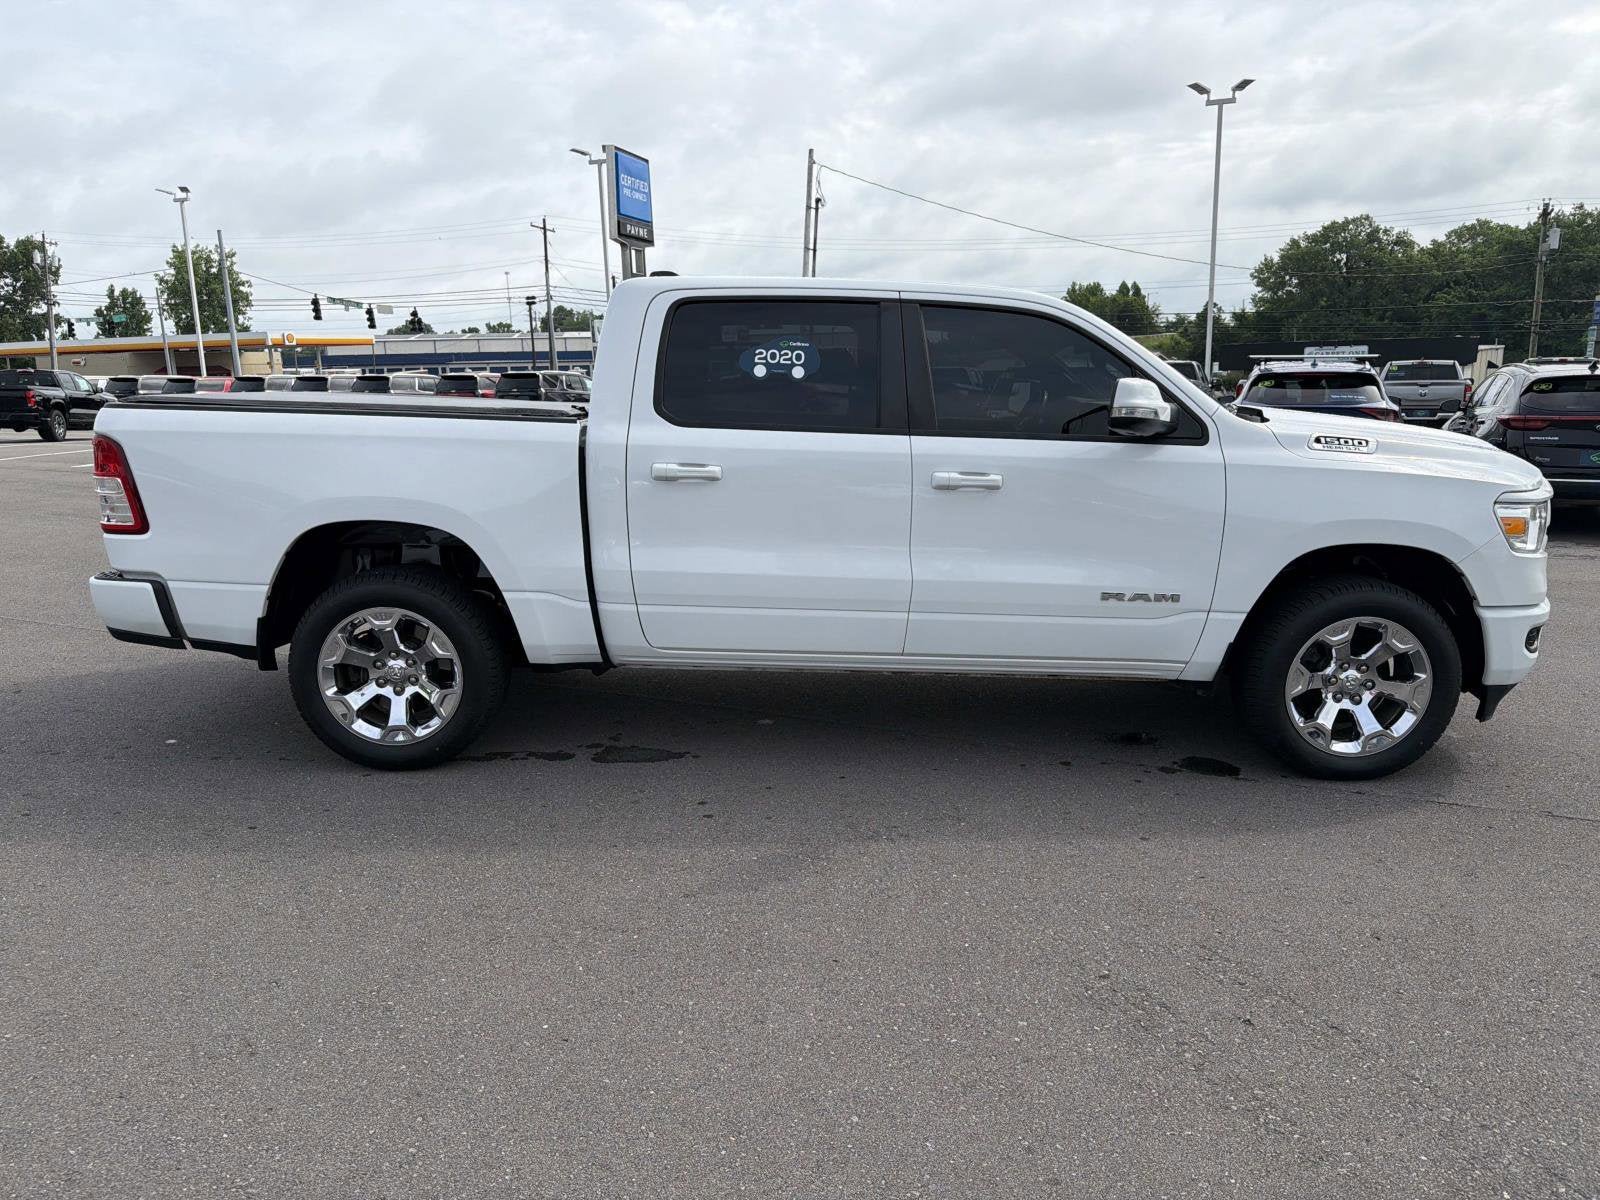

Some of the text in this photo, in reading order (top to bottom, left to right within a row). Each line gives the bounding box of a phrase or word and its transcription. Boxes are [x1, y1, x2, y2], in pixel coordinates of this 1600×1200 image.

[620, 173, 649, 193] CERTIFIED
[623, 188, 647, 202] PRE-OWNED
[626, 223, 648, 239] PAYNE
[754, 348, 805, 365] 2020
[1319, 436, 1368, 448] 1500
[1100, 591, 1181, 603] RAM
